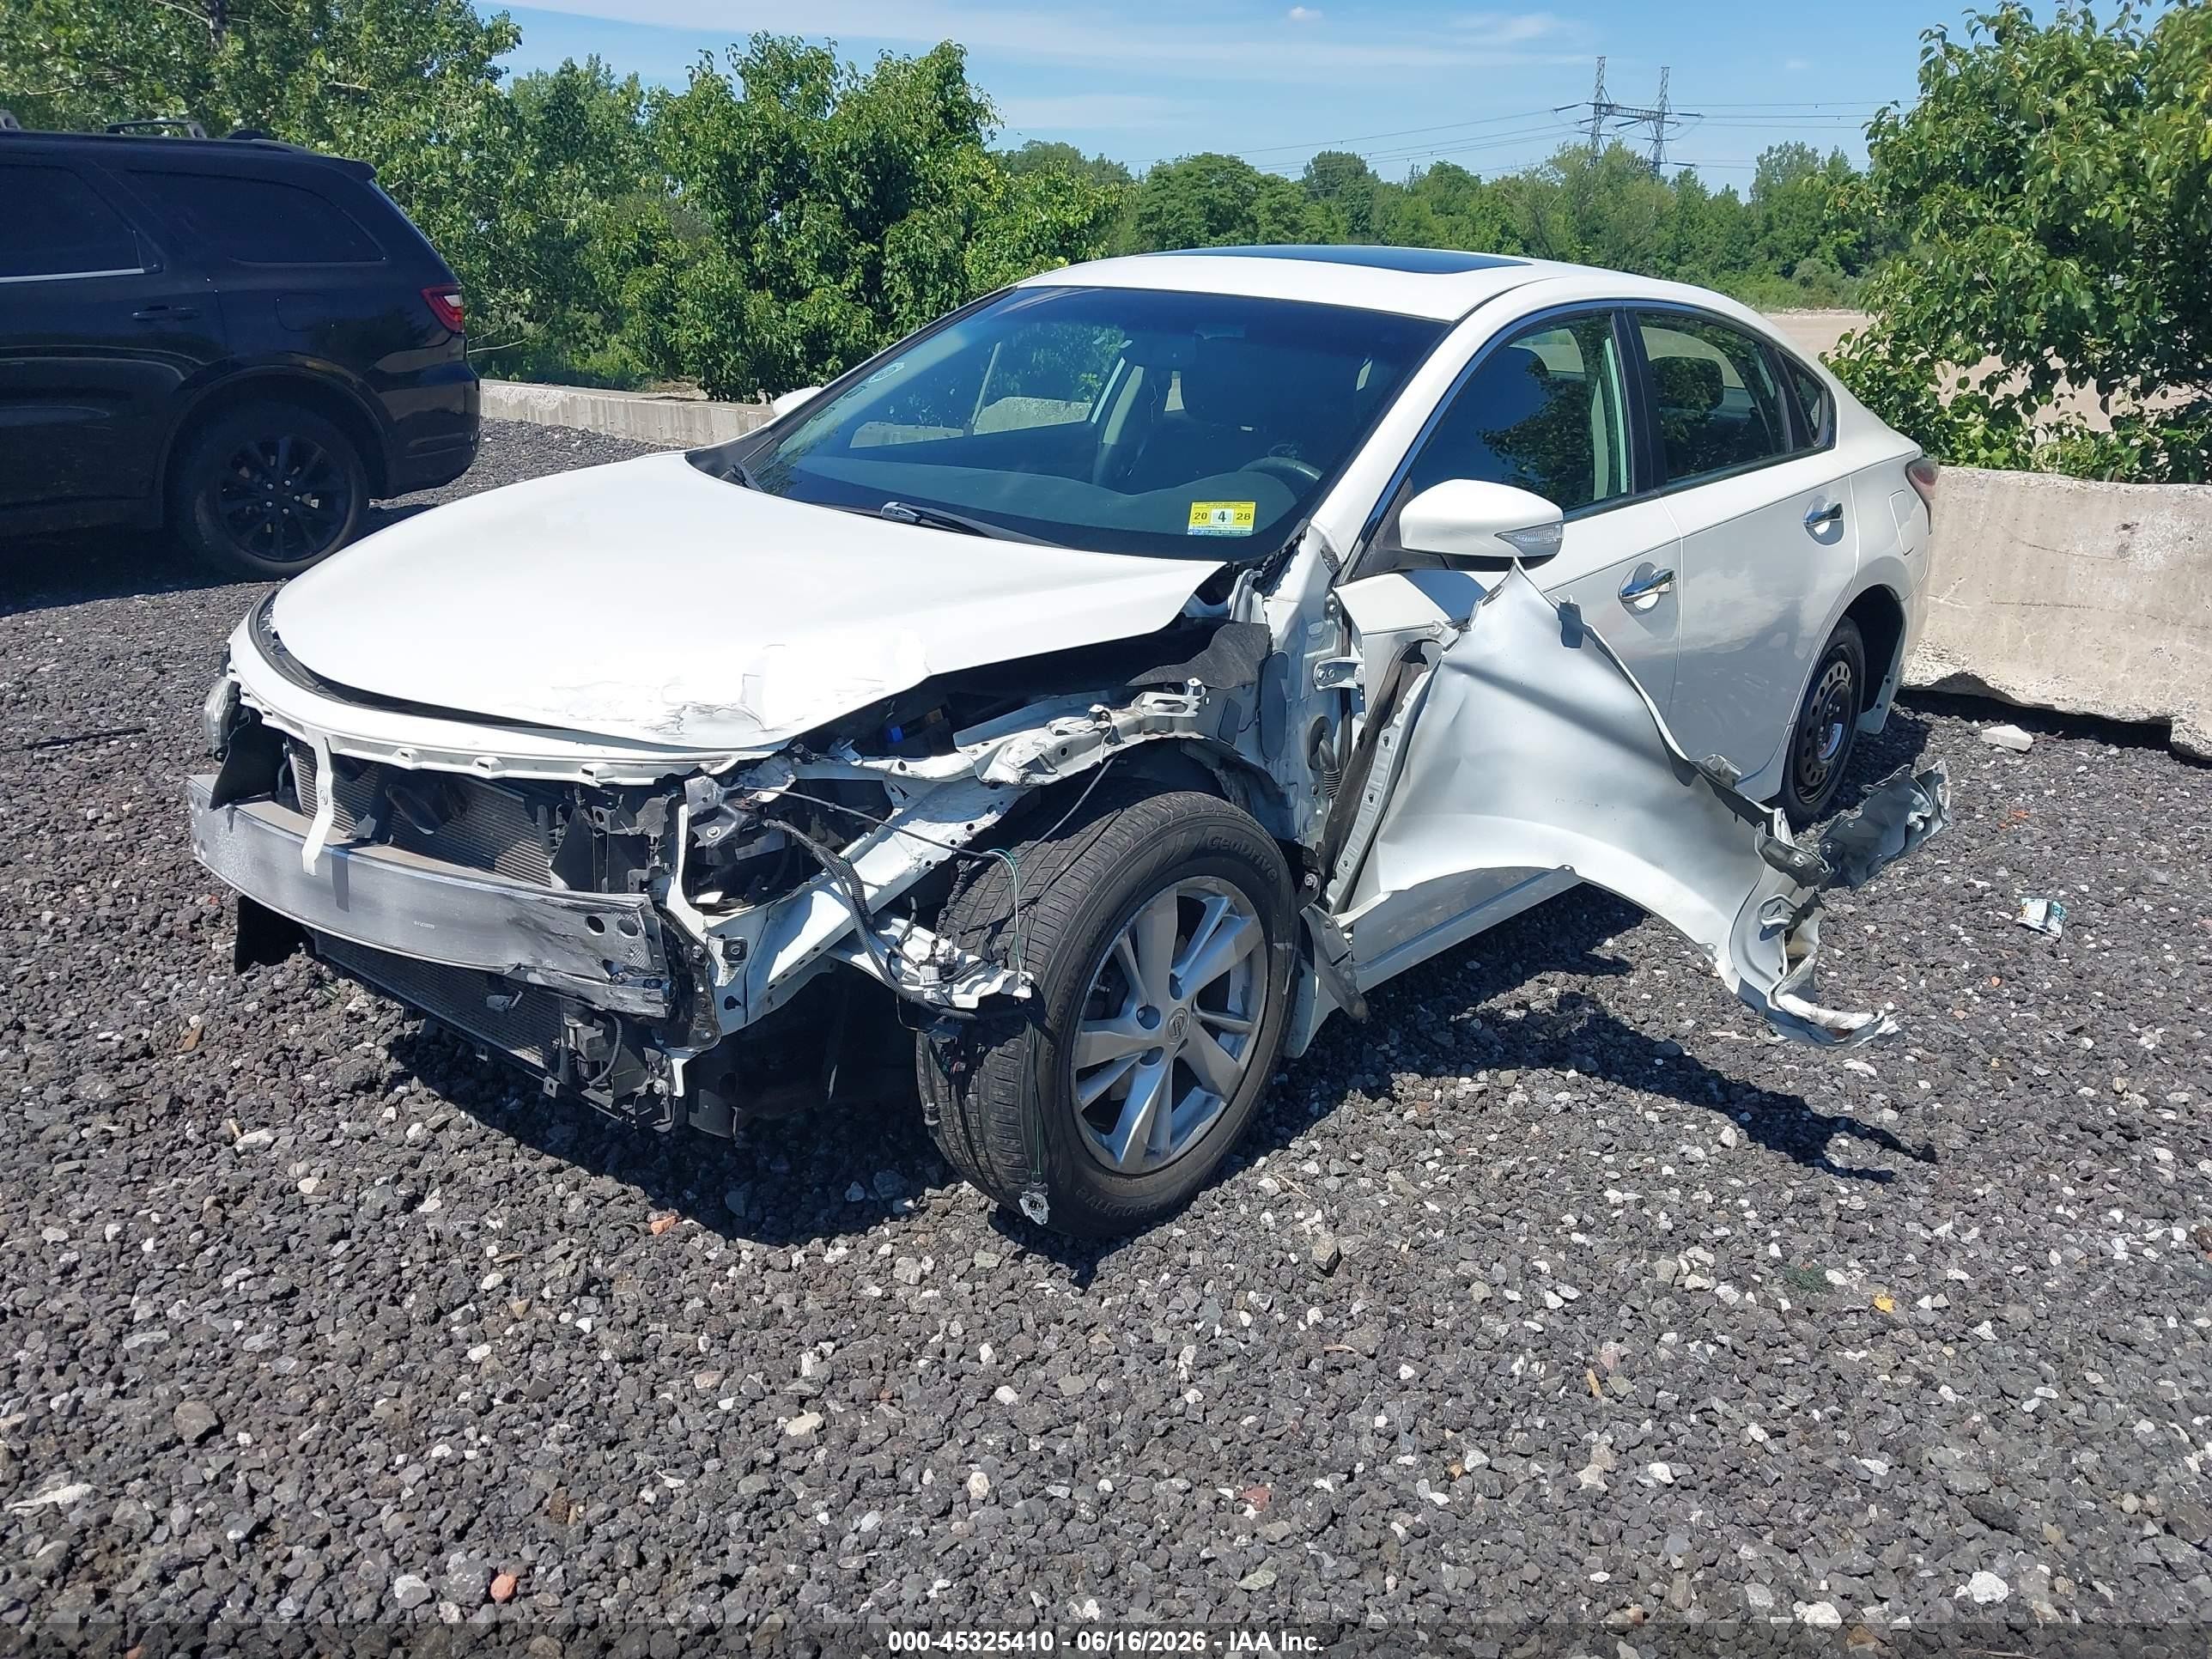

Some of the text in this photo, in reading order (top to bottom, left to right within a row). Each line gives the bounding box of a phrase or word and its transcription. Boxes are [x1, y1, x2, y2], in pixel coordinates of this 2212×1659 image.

[1194, 512, 1208, 520] 20
[1218, 510, 1227, 523] 4
[1206, 836, 1278, 881] GeoDrive
